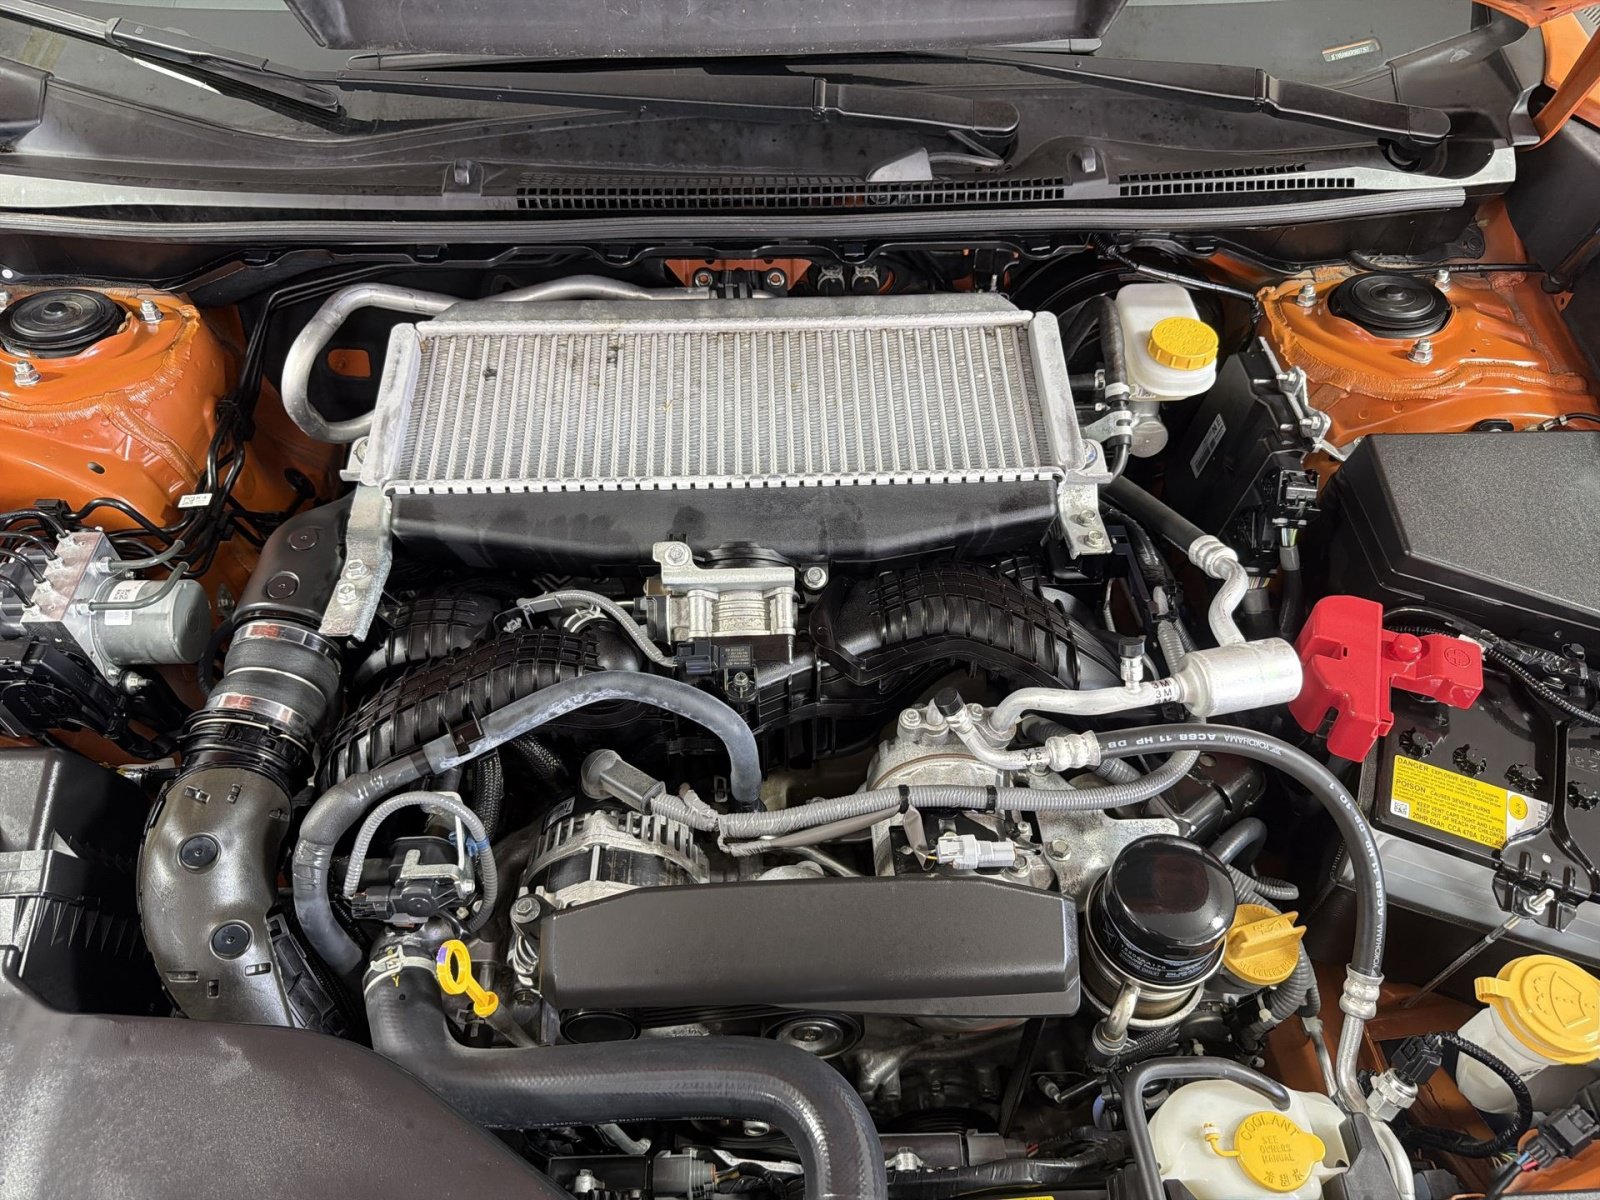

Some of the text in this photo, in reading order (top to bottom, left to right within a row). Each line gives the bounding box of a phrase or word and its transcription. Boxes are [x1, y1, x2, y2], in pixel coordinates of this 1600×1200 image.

[1136, 737, 1153, 745] HP
[1224, 734, 1270, 750] YOKOHAMA
[1397, 757, 1428, 772] DANGER
[1431, 768, 1457, 781] EXPLOSIVE
[1460, 778, 1476, 787] GASES
[1395, 778, 1425, 793] POISON
[1430, 790, 1450, 801] CAUSES
[1452, 797, 1471, 808] SEVERE
[1473, 804, 1490, 814] BURNS
[1445, 810, 1459, 819] CAPS
[1447, 823, 1461, 833] CCA
[1451, 818, 1468, 828] REACH
[1373, 923, 1383, 968] YOKOHAMA
[1240, 1114, 1300, 1141] COOLANT
[1262, 1135, 1279, 1144] SEE
